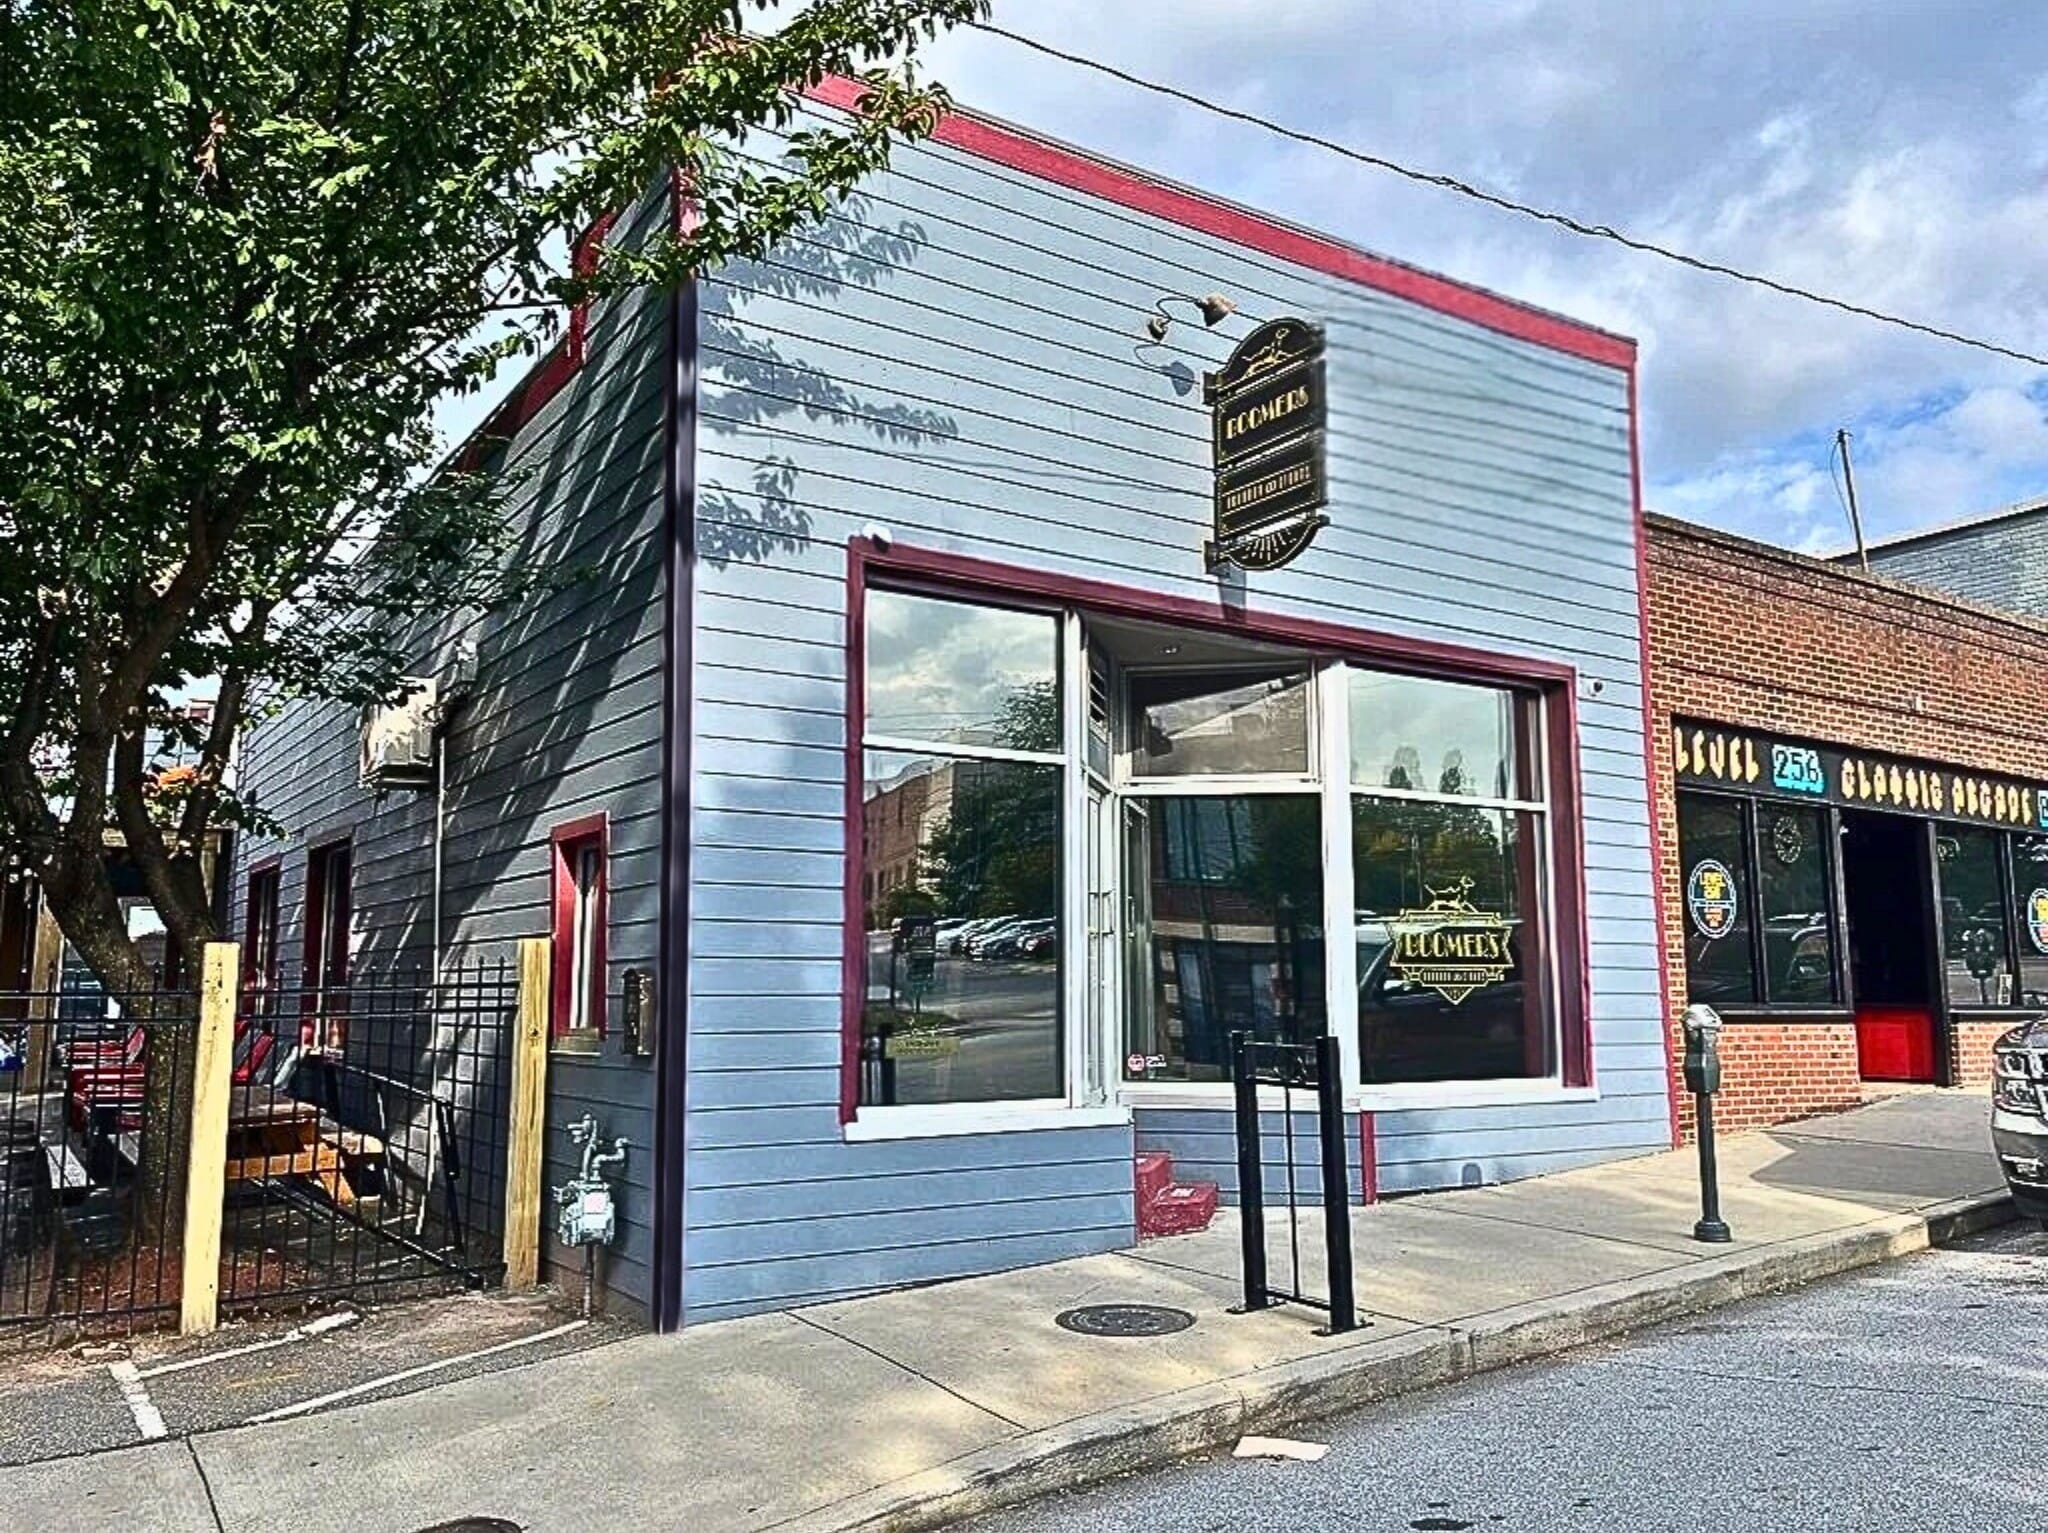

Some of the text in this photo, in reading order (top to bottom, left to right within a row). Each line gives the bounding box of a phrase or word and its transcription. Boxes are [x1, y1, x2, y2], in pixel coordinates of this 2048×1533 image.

[1674, 726, 1759, 783] LEVEL
[1772, 744, 1824, 793] 256
[1841, 758, 1943, 812] CLASSIC
[1952, 776, 2032, 825] ARCADE
